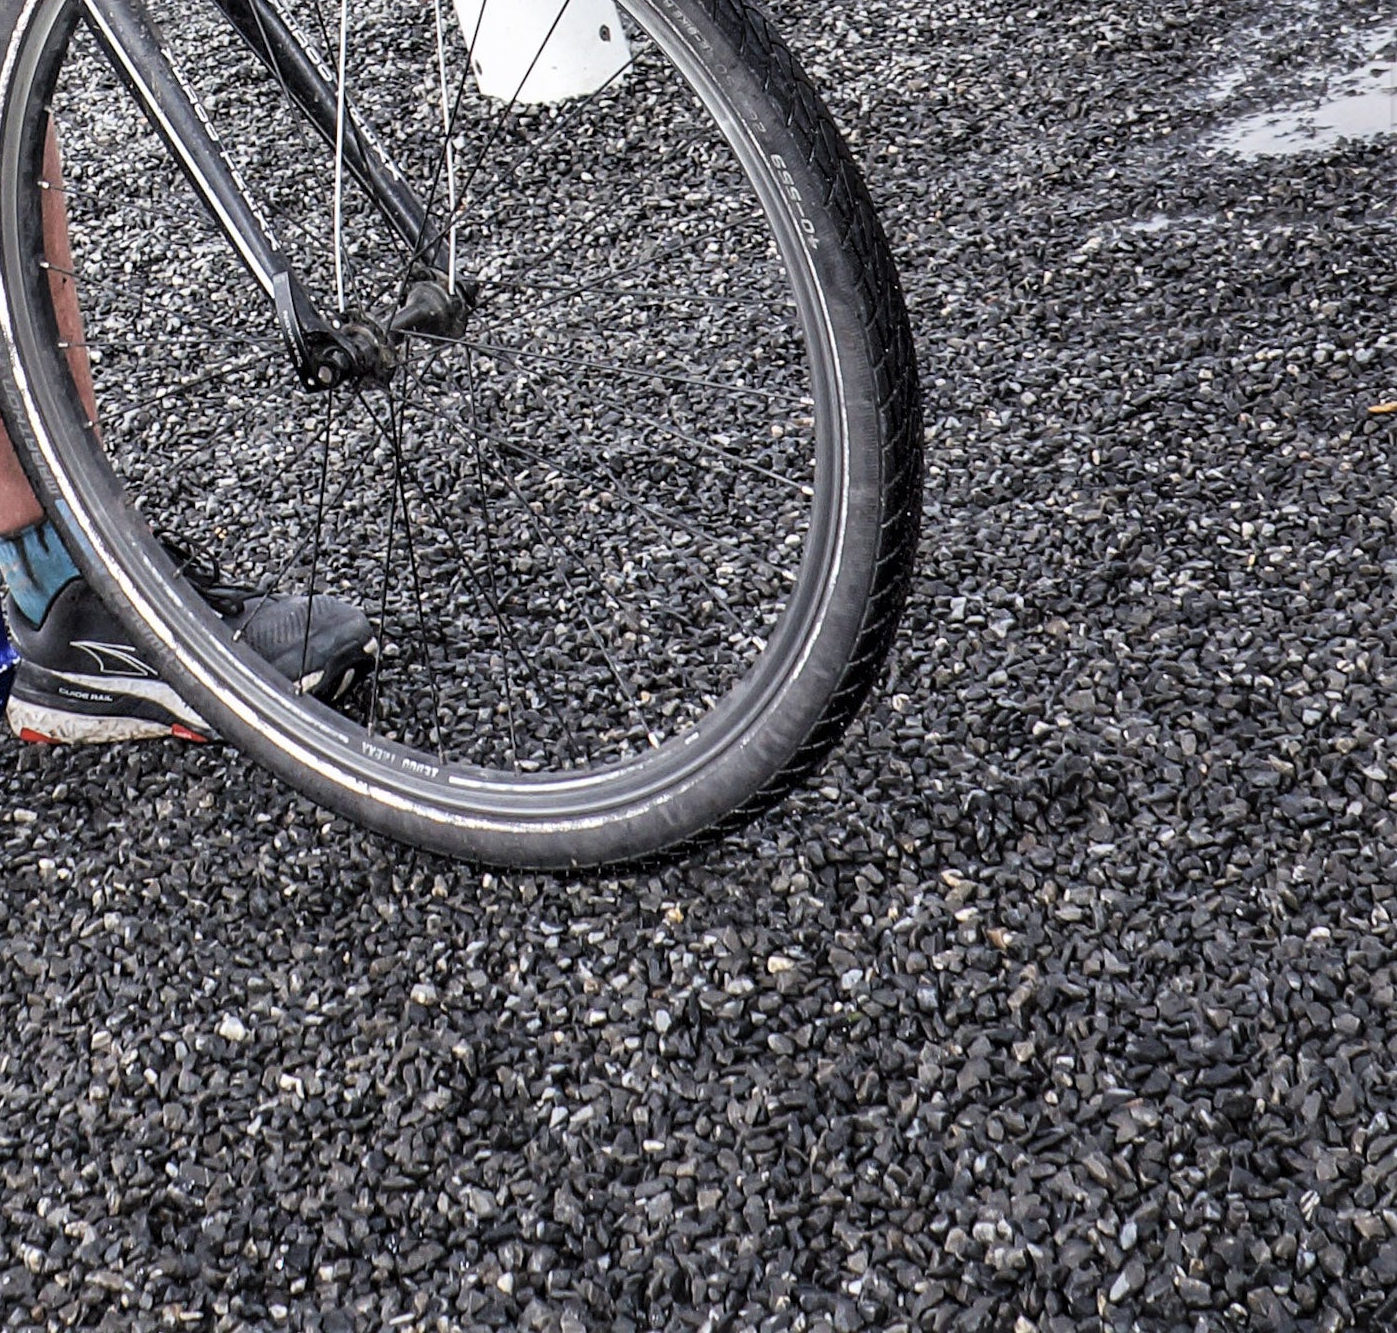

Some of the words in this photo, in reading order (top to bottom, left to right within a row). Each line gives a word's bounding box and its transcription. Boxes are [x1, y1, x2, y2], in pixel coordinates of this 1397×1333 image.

[335, 90, 400, 181] REXX
[2, 378, 59, 496] MARATHON
[58, 687, 90, 700] GUIDE
[90, 693, 113, 702] RAIL
